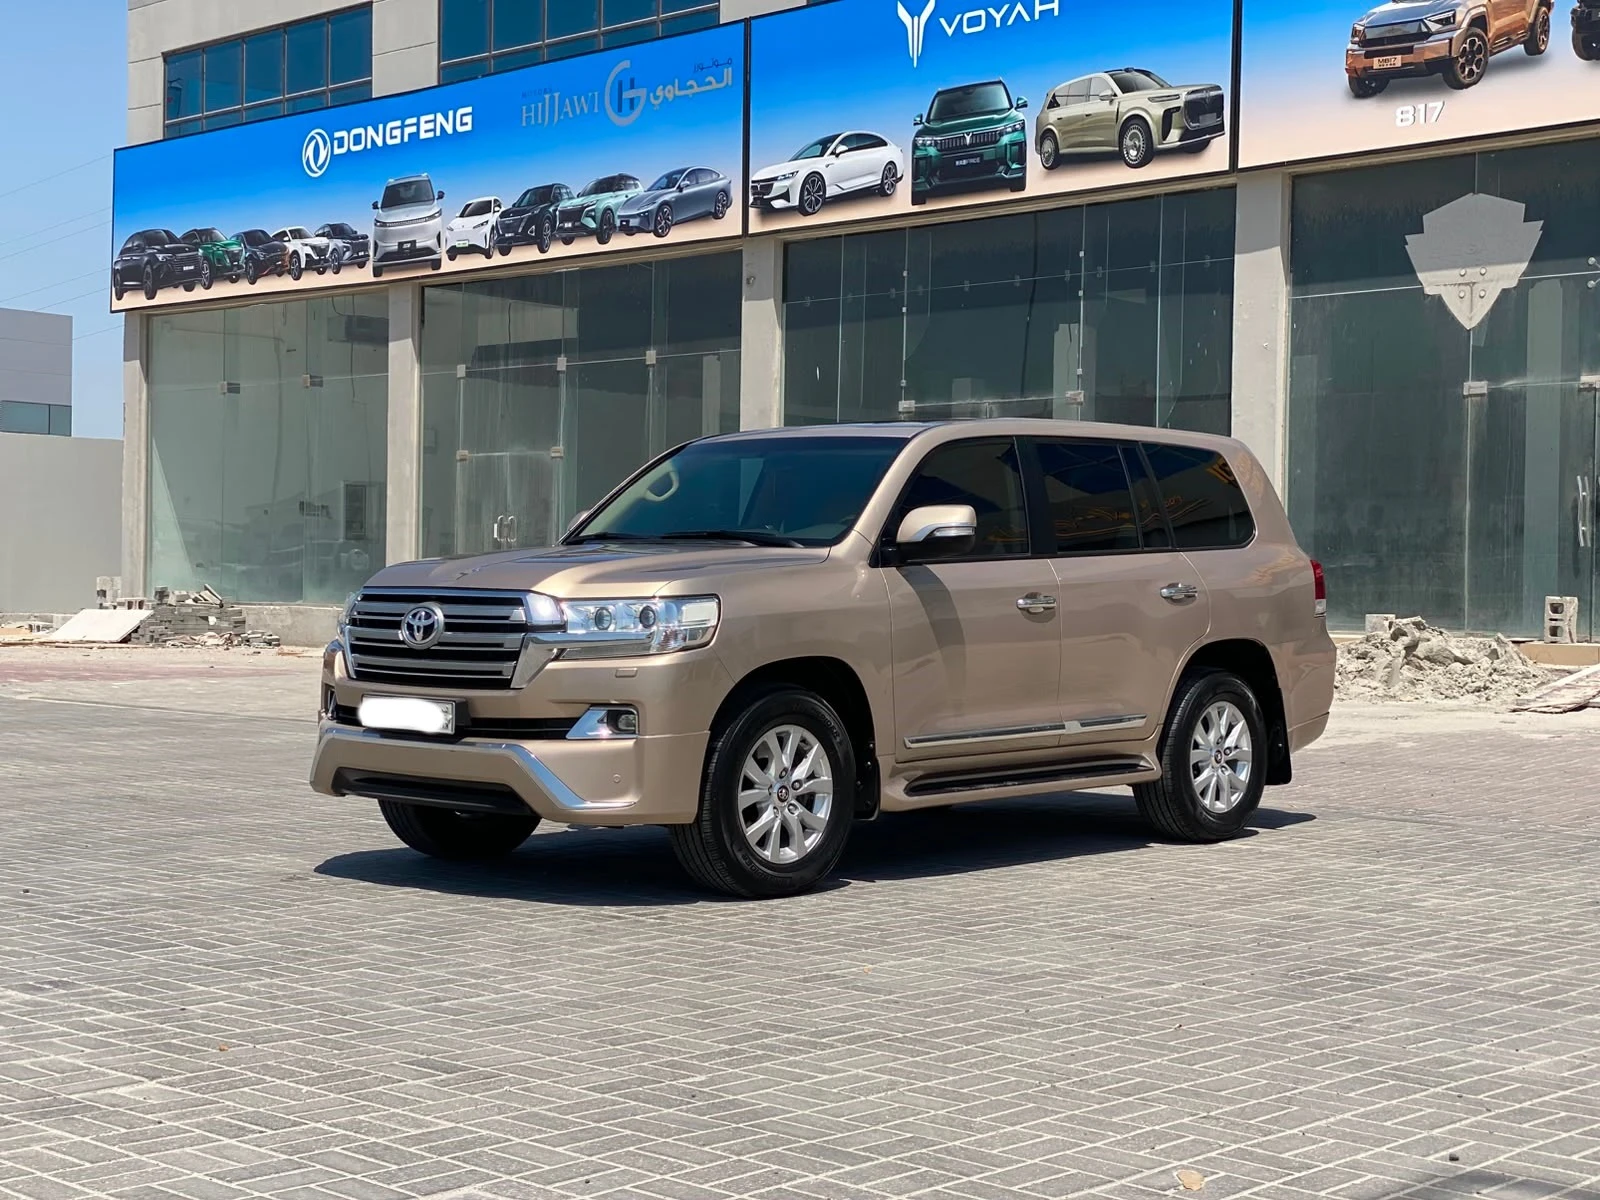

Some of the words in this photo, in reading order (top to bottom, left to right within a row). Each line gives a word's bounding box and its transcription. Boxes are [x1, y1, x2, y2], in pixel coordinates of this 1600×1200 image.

[939, 0, 1059, 37] VOYAH
[649, 67, 733, 111] الحجاوي
[333, 106, 473, 156] DONGFENG
[1395, 101, 1445, 127] 817
